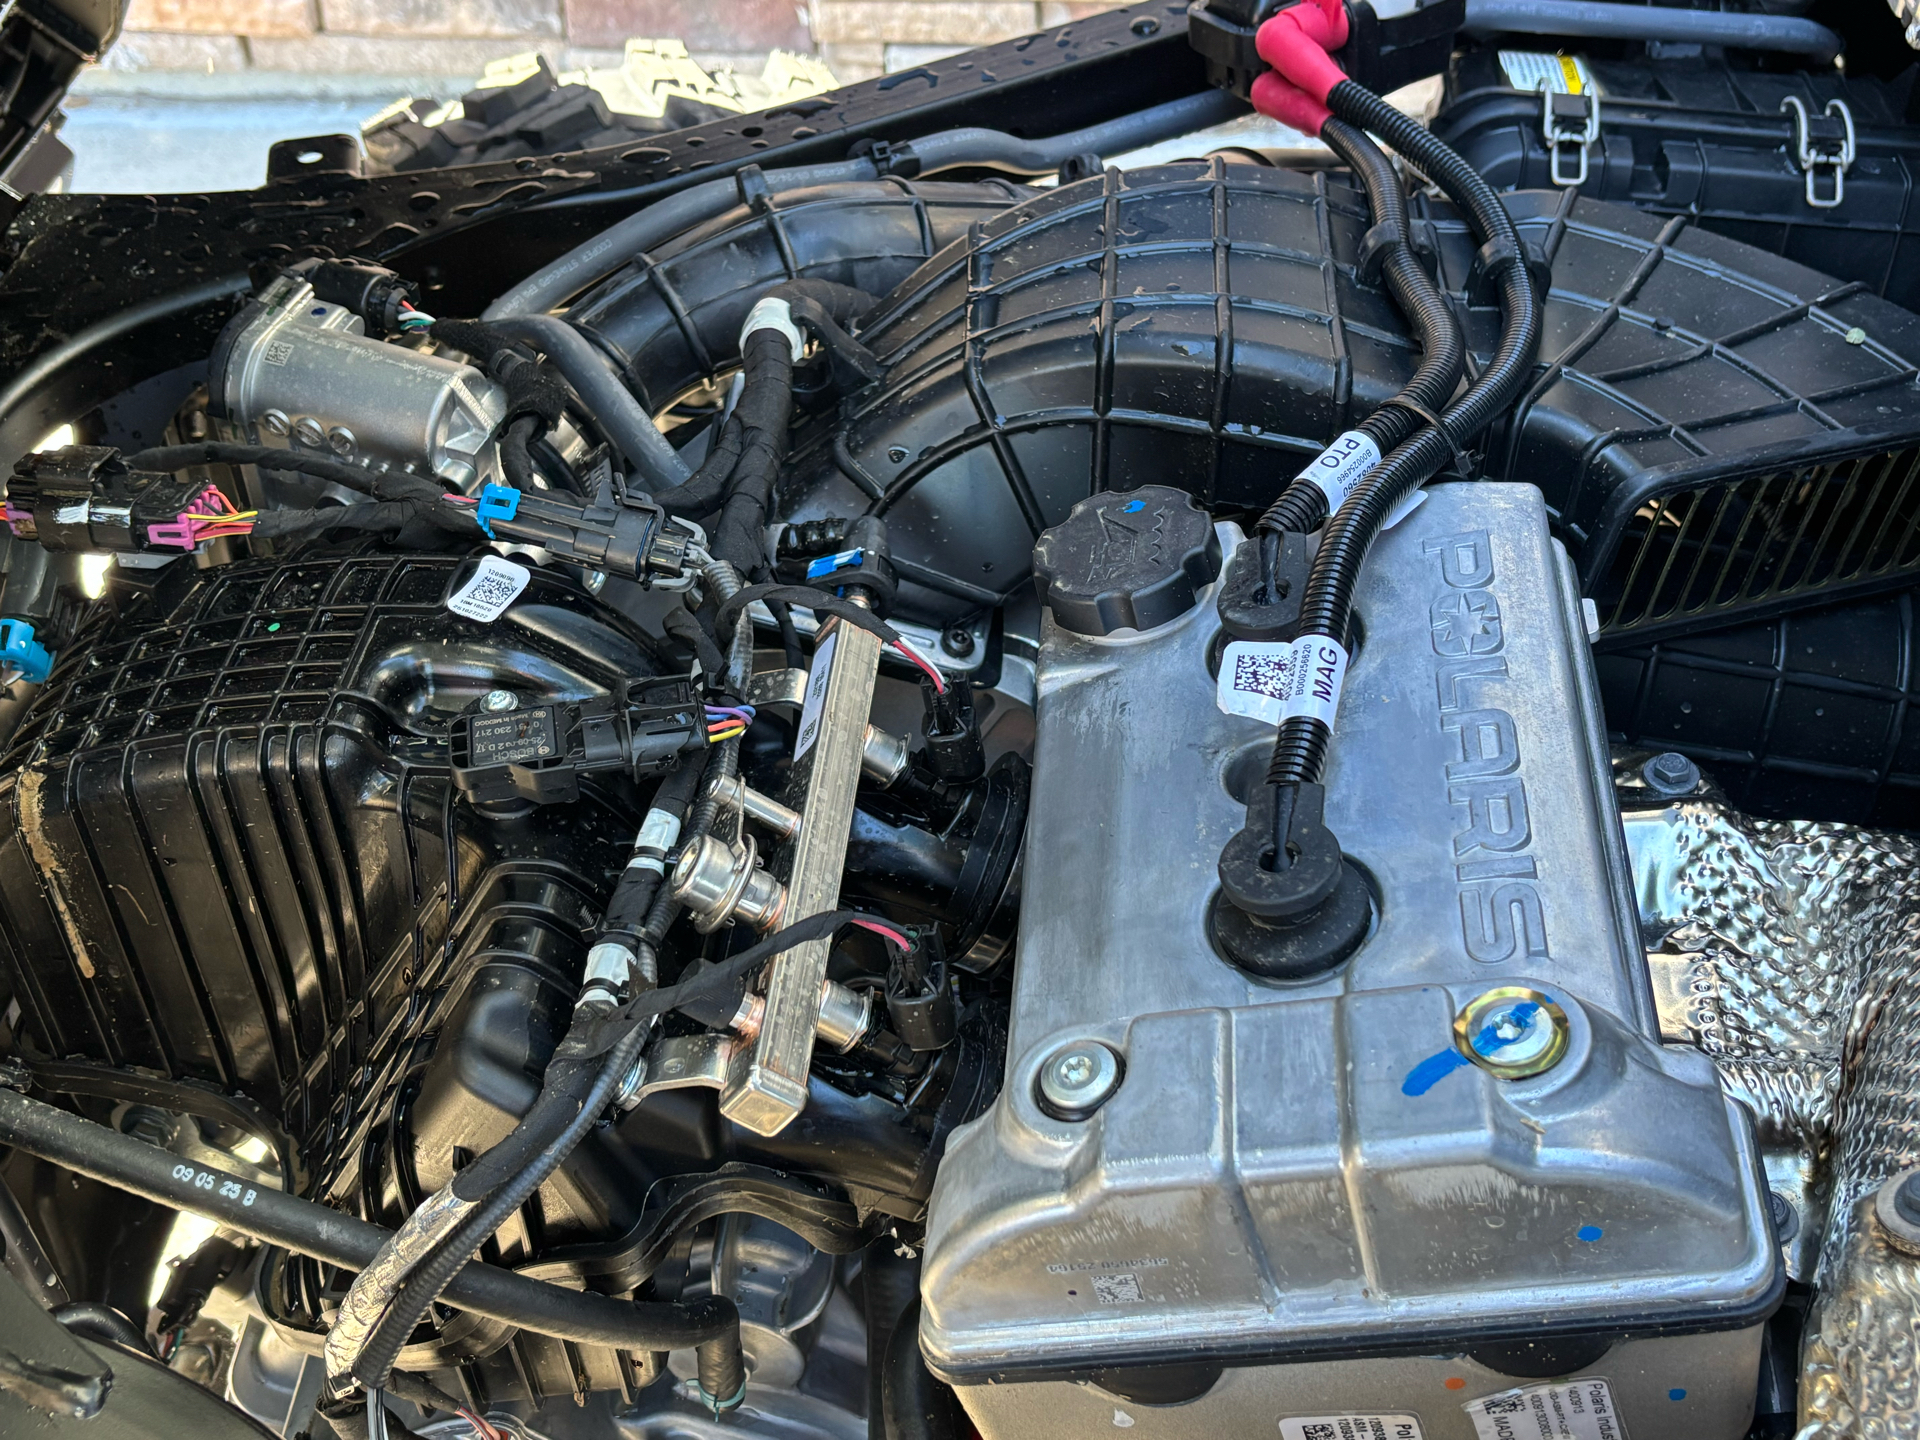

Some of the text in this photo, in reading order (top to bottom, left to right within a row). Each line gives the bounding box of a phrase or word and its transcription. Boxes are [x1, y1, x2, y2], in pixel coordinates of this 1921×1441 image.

[580, 237, 613, 263] COOPER
[1320, 435, 1360, 472] PTO
[1335, 448, 1372, 484] B000254966
[1312, 645, 1338, 702] MAG
[473, 728, 492, 737] 217
[493, 725, 511, 734] 230
[492, 746, 534, 760] BOSCH
[1422, 529, 1550, 963] POLARIS
[172, 1164, 195, 1182] 09
[194, 1171, 216, 1190] 05
[1587, 1383, 1618, 1440] Polaris Indus
[1352, 1417, 1368, 1433] ASM
[1395, 1424, 1415, 1440] Pol
